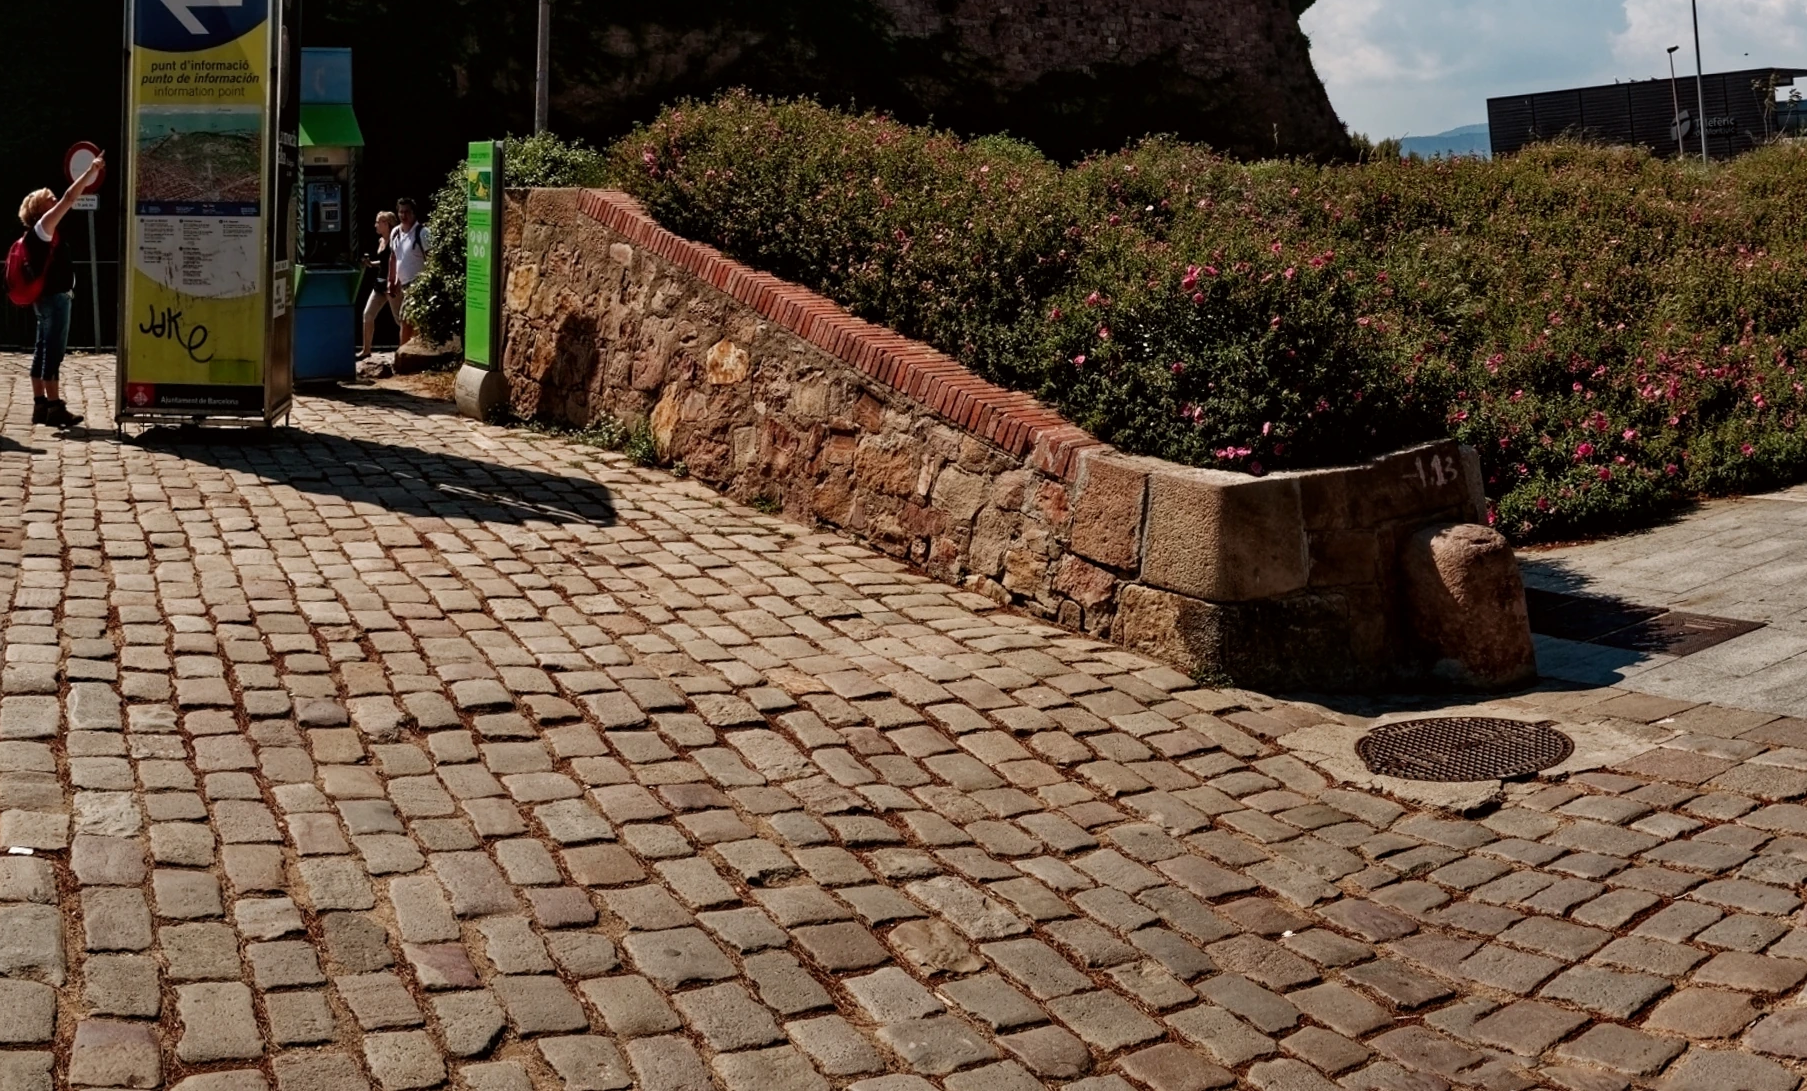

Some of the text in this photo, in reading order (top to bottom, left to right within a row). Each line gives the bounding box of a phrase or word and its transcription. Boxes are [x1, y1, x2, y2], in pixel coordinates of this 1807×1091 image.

[151, 59, 249, 73] punt d'informació
[141, 73, 259, 86] punto de información
[154, 86, 245, 98] information point
[160, 396, 198, 405] Ajuntament
